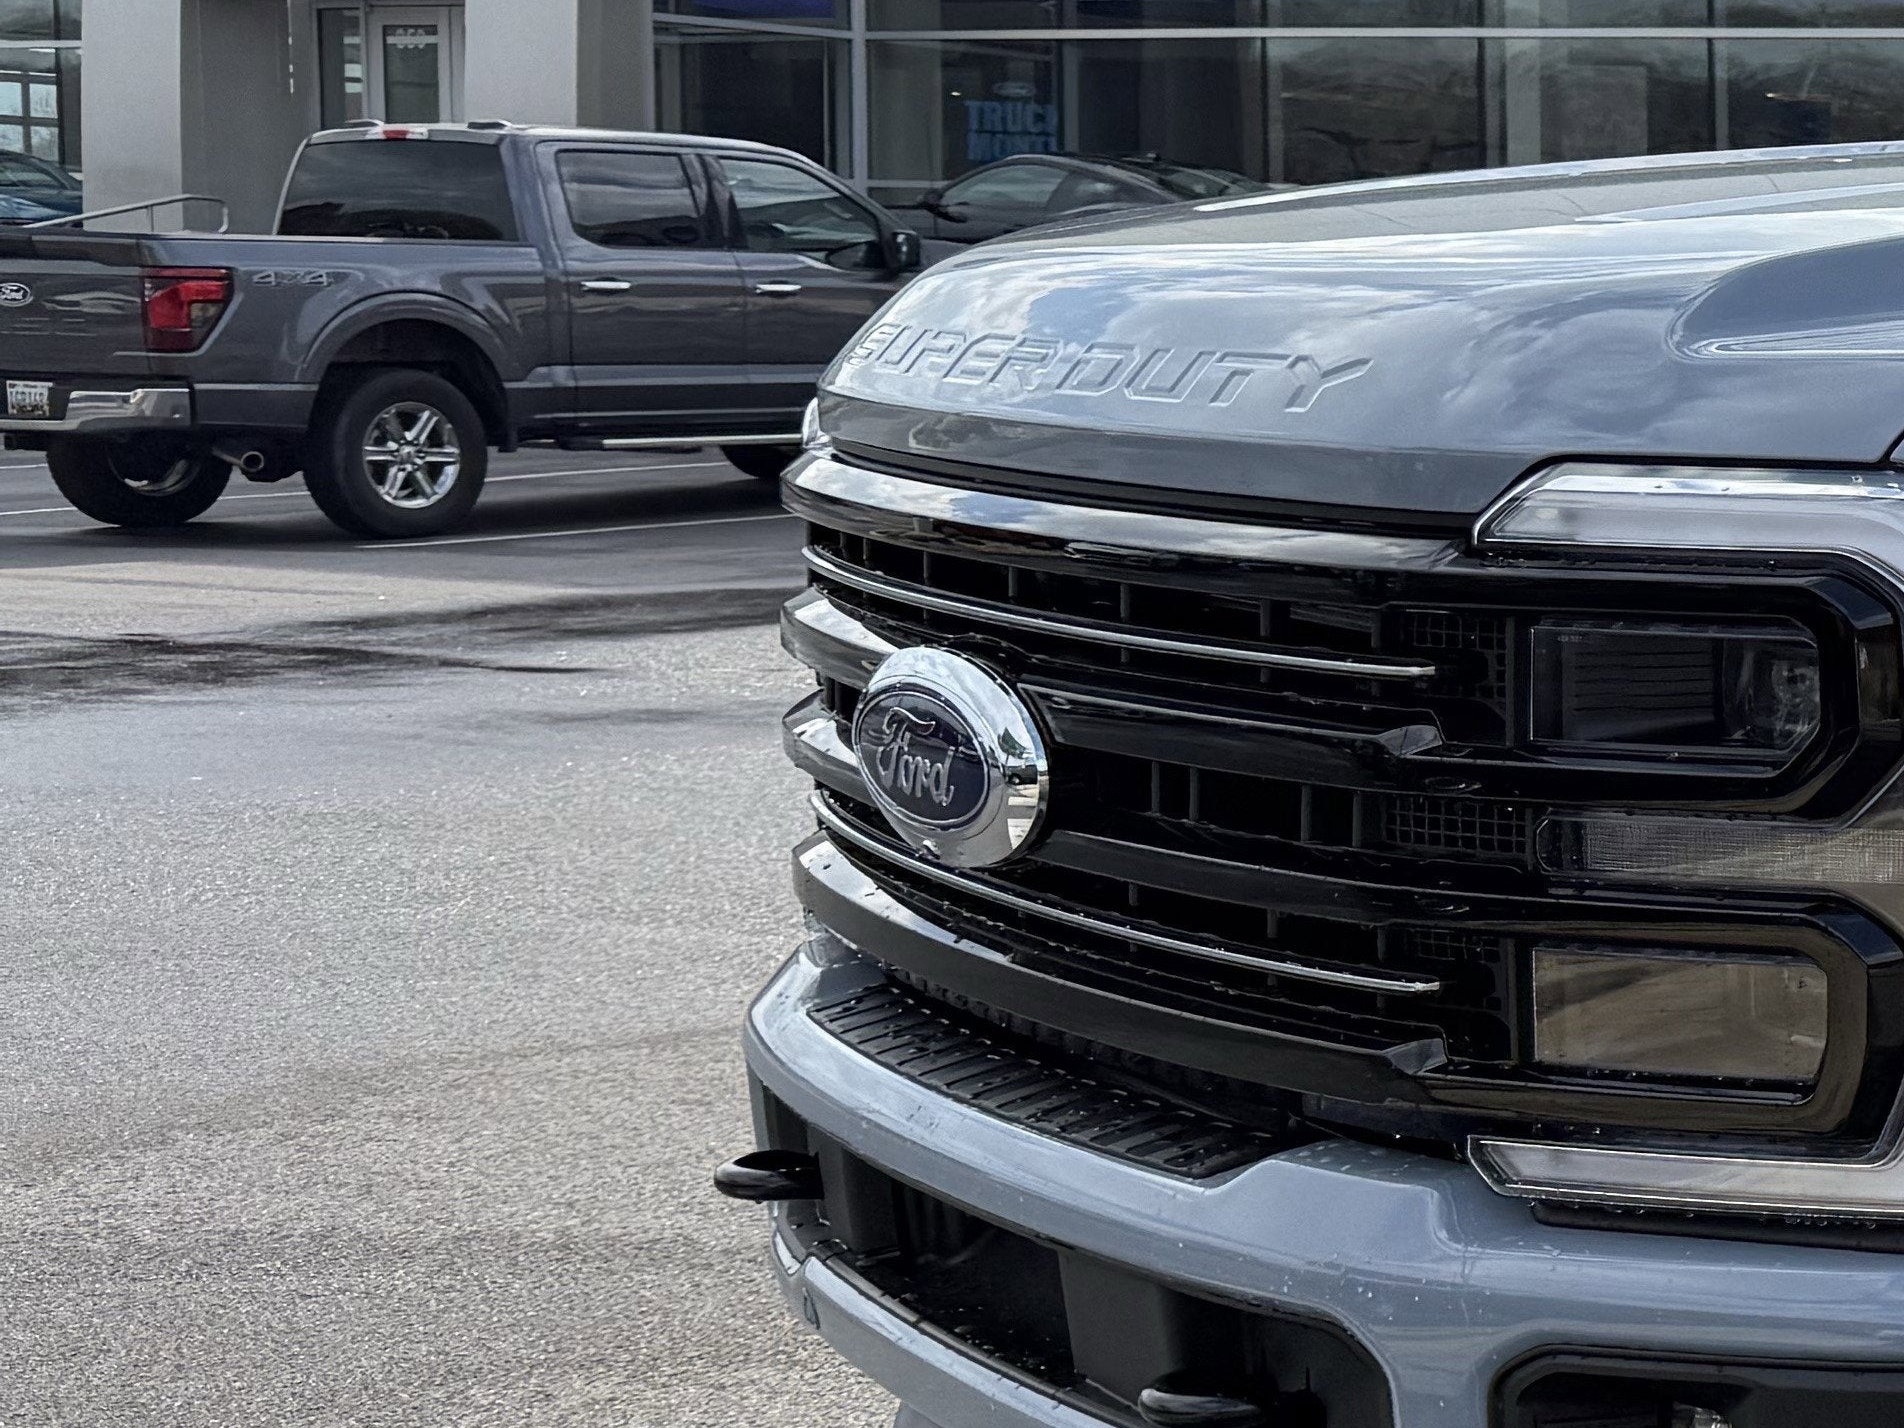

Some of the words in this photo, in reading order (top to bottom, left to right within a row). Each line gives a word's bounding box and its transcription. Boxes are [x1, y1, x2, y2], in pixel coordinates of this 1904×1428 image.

[848, 323, 1063, 392] SUPER
[1055, 341, 1376, 413] DUTY
[875, 706, 955, 806] Ford
